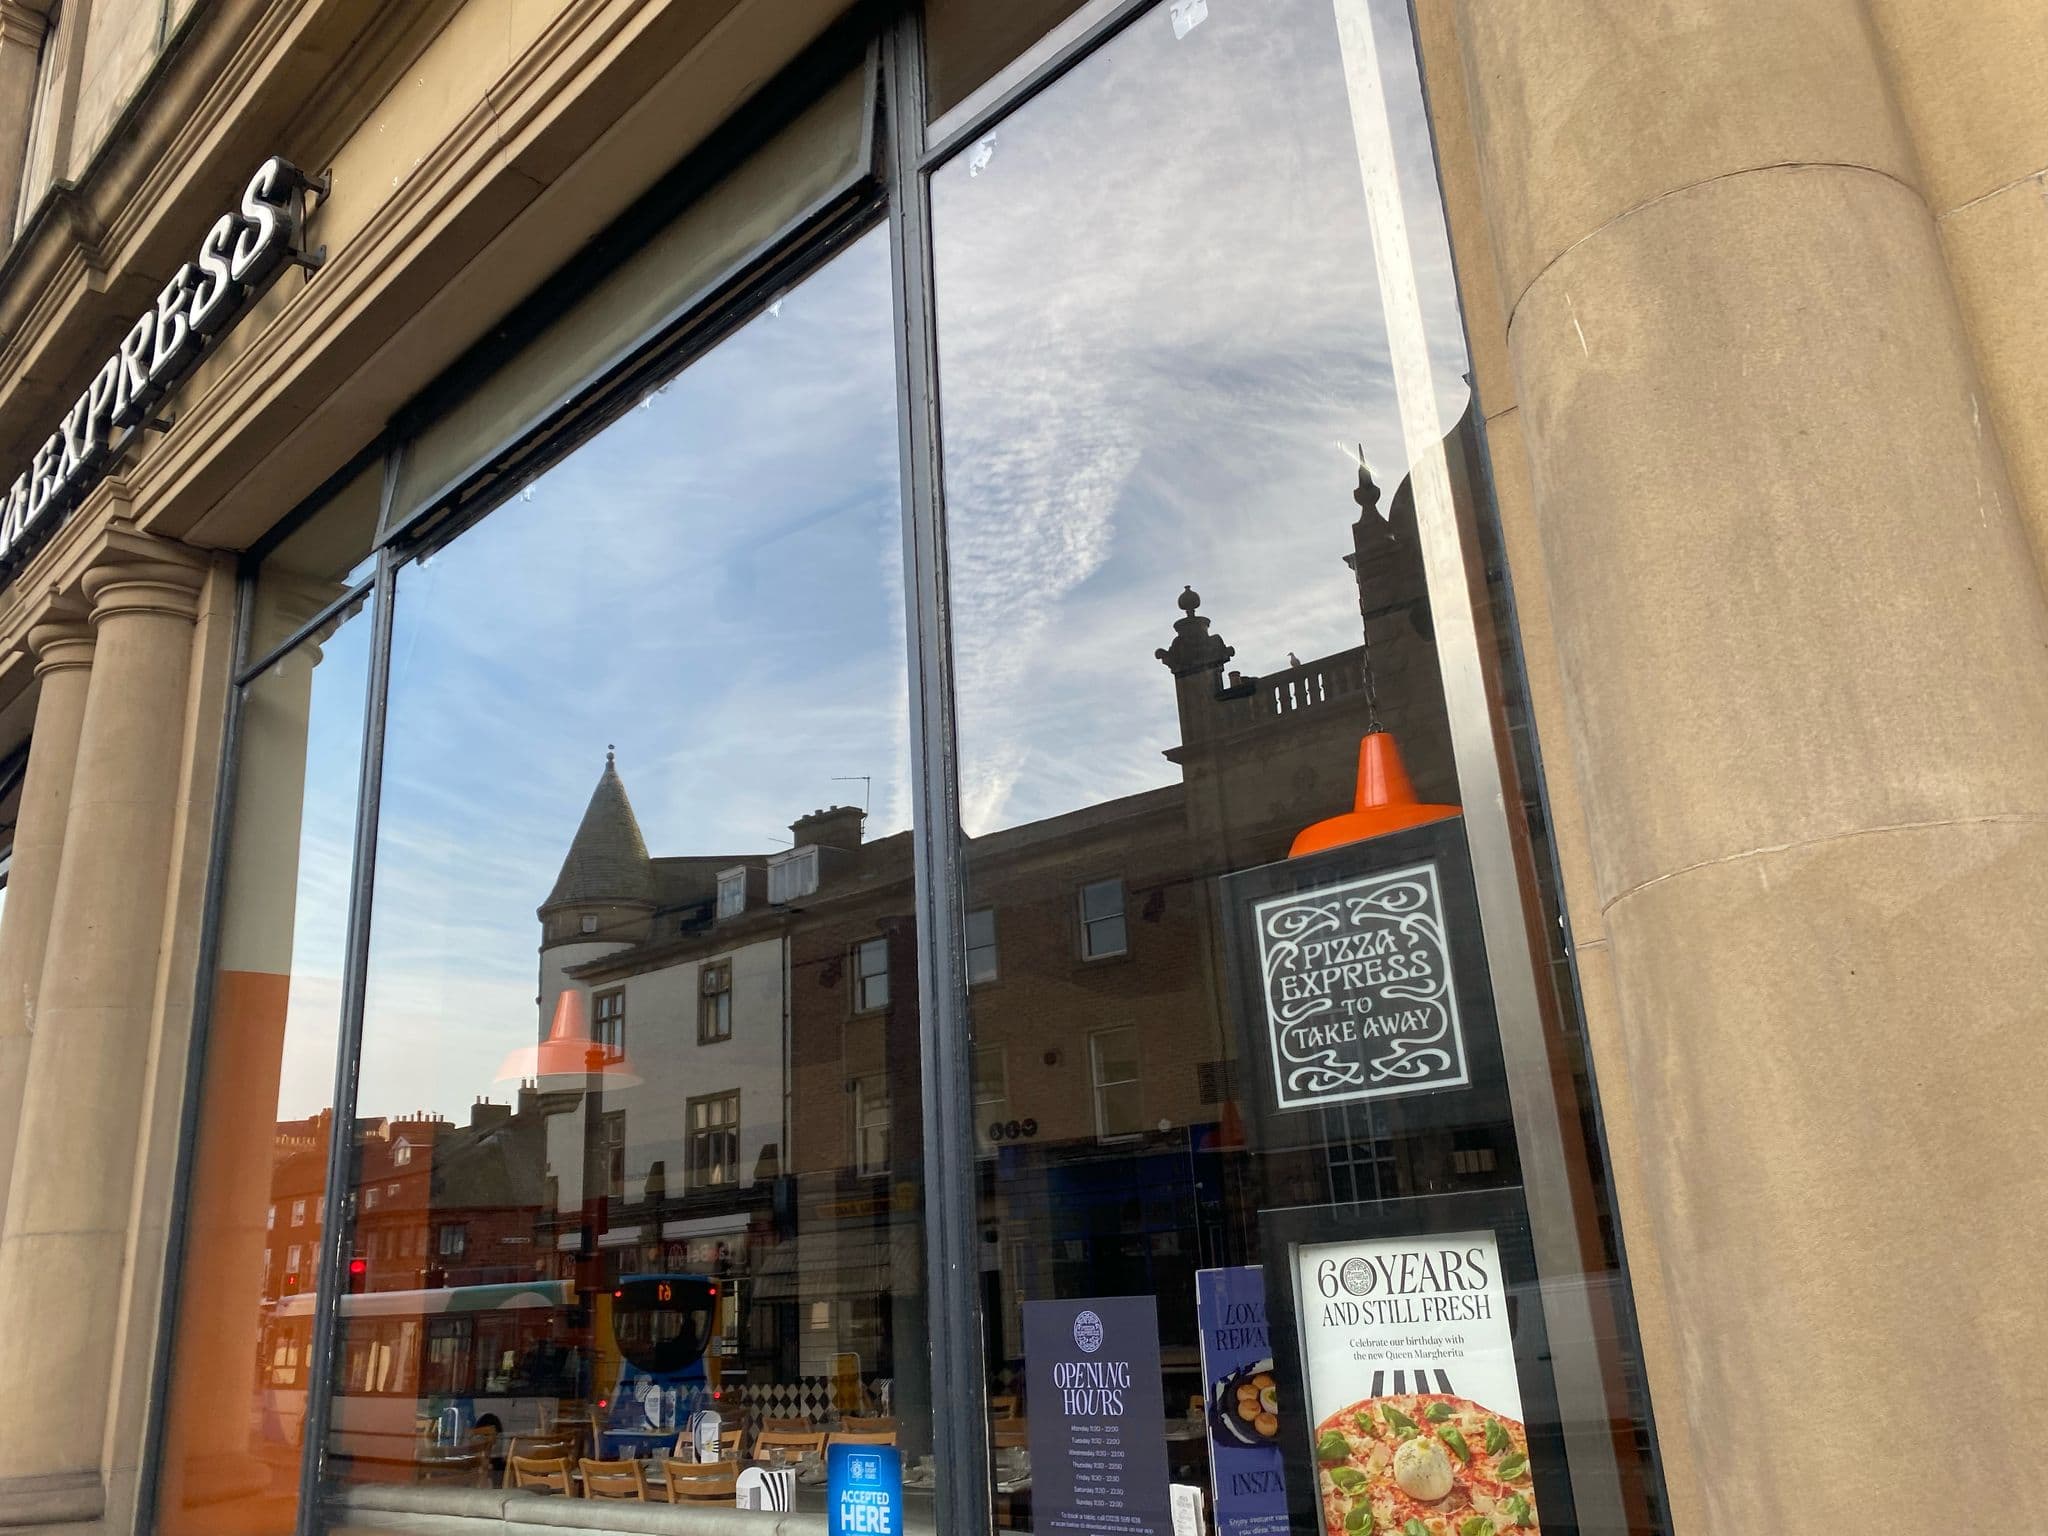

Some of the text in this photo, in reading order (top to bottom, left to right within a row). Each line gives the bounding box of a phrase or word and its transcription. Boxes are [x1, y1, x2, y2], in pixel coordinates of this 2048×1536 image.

[1302, 928, 1399, 970] PIZZA
[1280, 950, 1432, 1001] EXPRESS
[1341, 997, 1372, 1016] TO
[1291, 1008, 1431, 1049] TAKE AWAY
[1225, 1303, 1261, 1325] LOY
[1323, 1294, 1492, 1326] AND STILL FRESH
[1216, 1327, 1268, 1351] REWA
[1349, 1338, 1389, 1348] Celebrate
[1405, 1335, 1443, 1347] birthday
[1444, 1334, 1465, 1345] with
[1353, 1351, 1367, 1360] the
[1385, 1350, 1413, 1360] Queen
[1414, 1348, 1464, 1360] Margherita
[1053, 1361, 1131, 1389] OPENING
[1063, 1389, 1124, 1416] HOURS
[1232, 1471, 1284, 1496] INSTA
[841, 1489, 889, 1505] ACCEPTED
[841, 1503, 891, 1534] HERE
